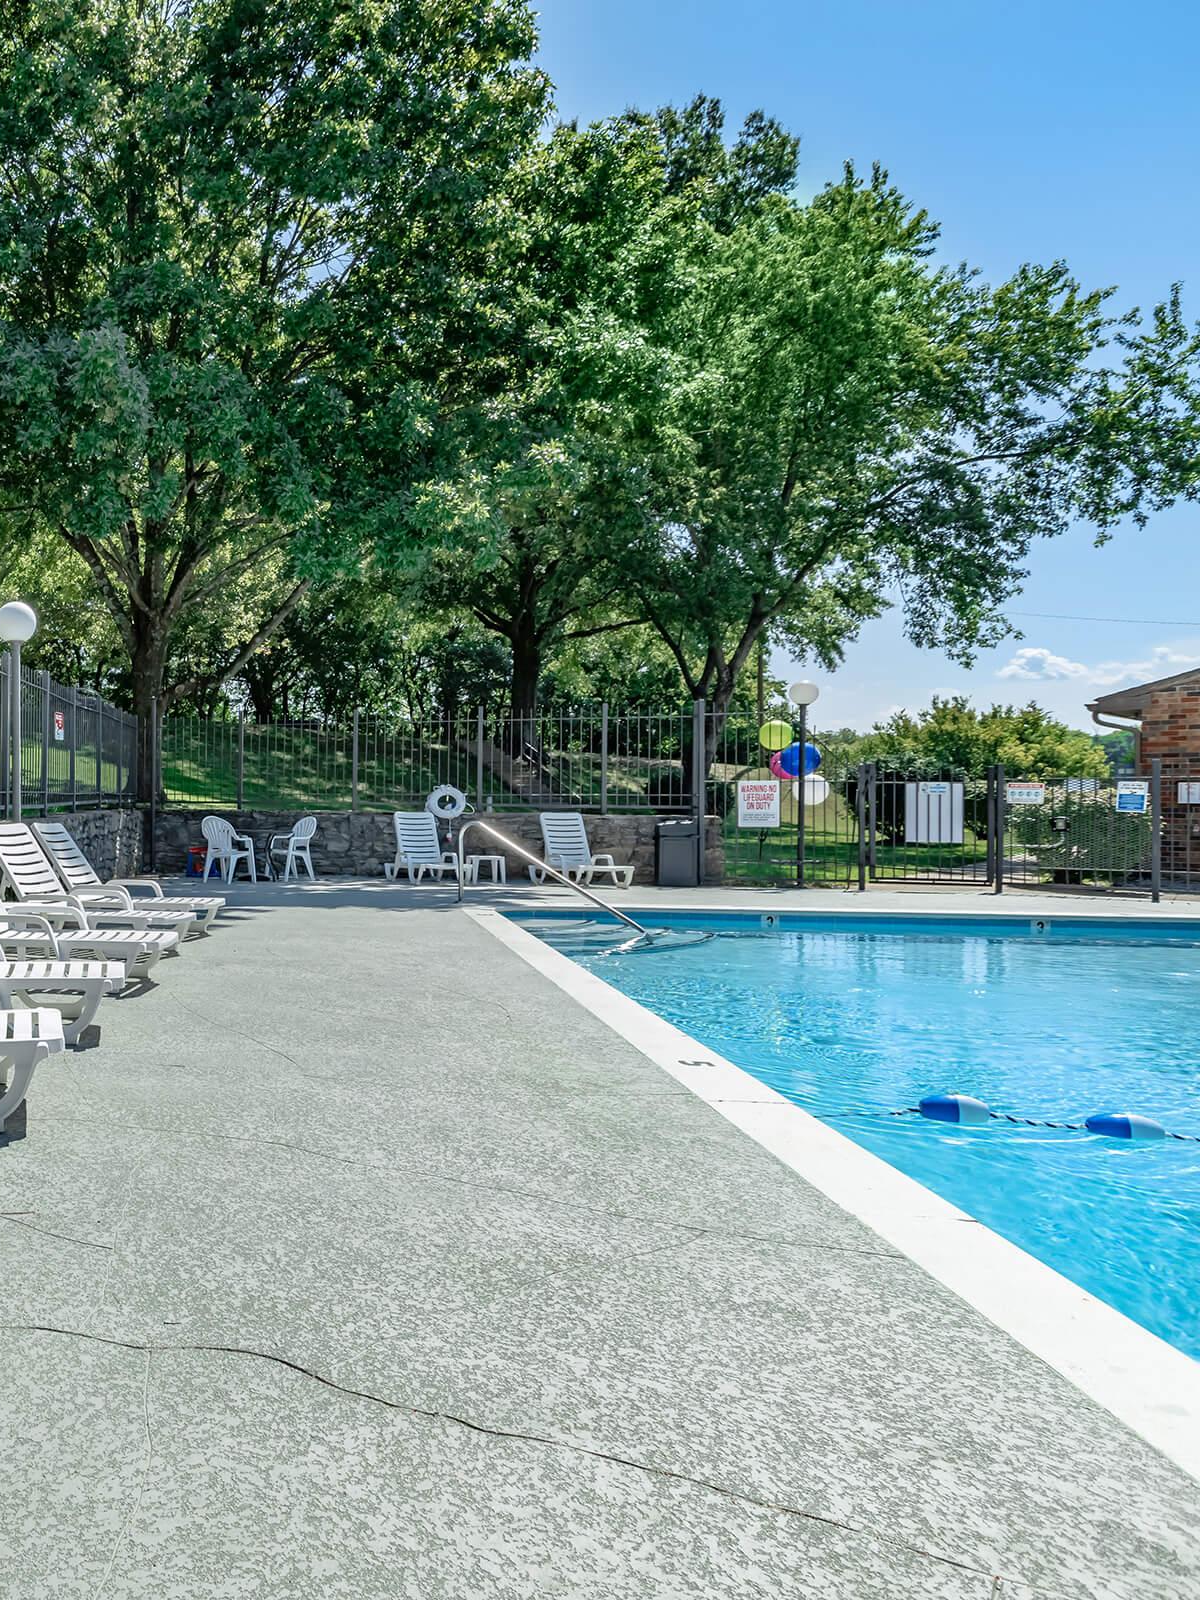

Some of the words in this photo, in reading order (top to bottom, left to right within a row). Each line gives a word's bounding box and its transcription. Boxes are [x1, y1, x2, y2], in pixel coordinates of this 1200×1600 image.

[741, 784, 767, 793] WARNING
[743, 793, 775, 801] LIFEGUARD
[746, 801, 755, 810] ON
[755, 801, 770, 810] DUTY
